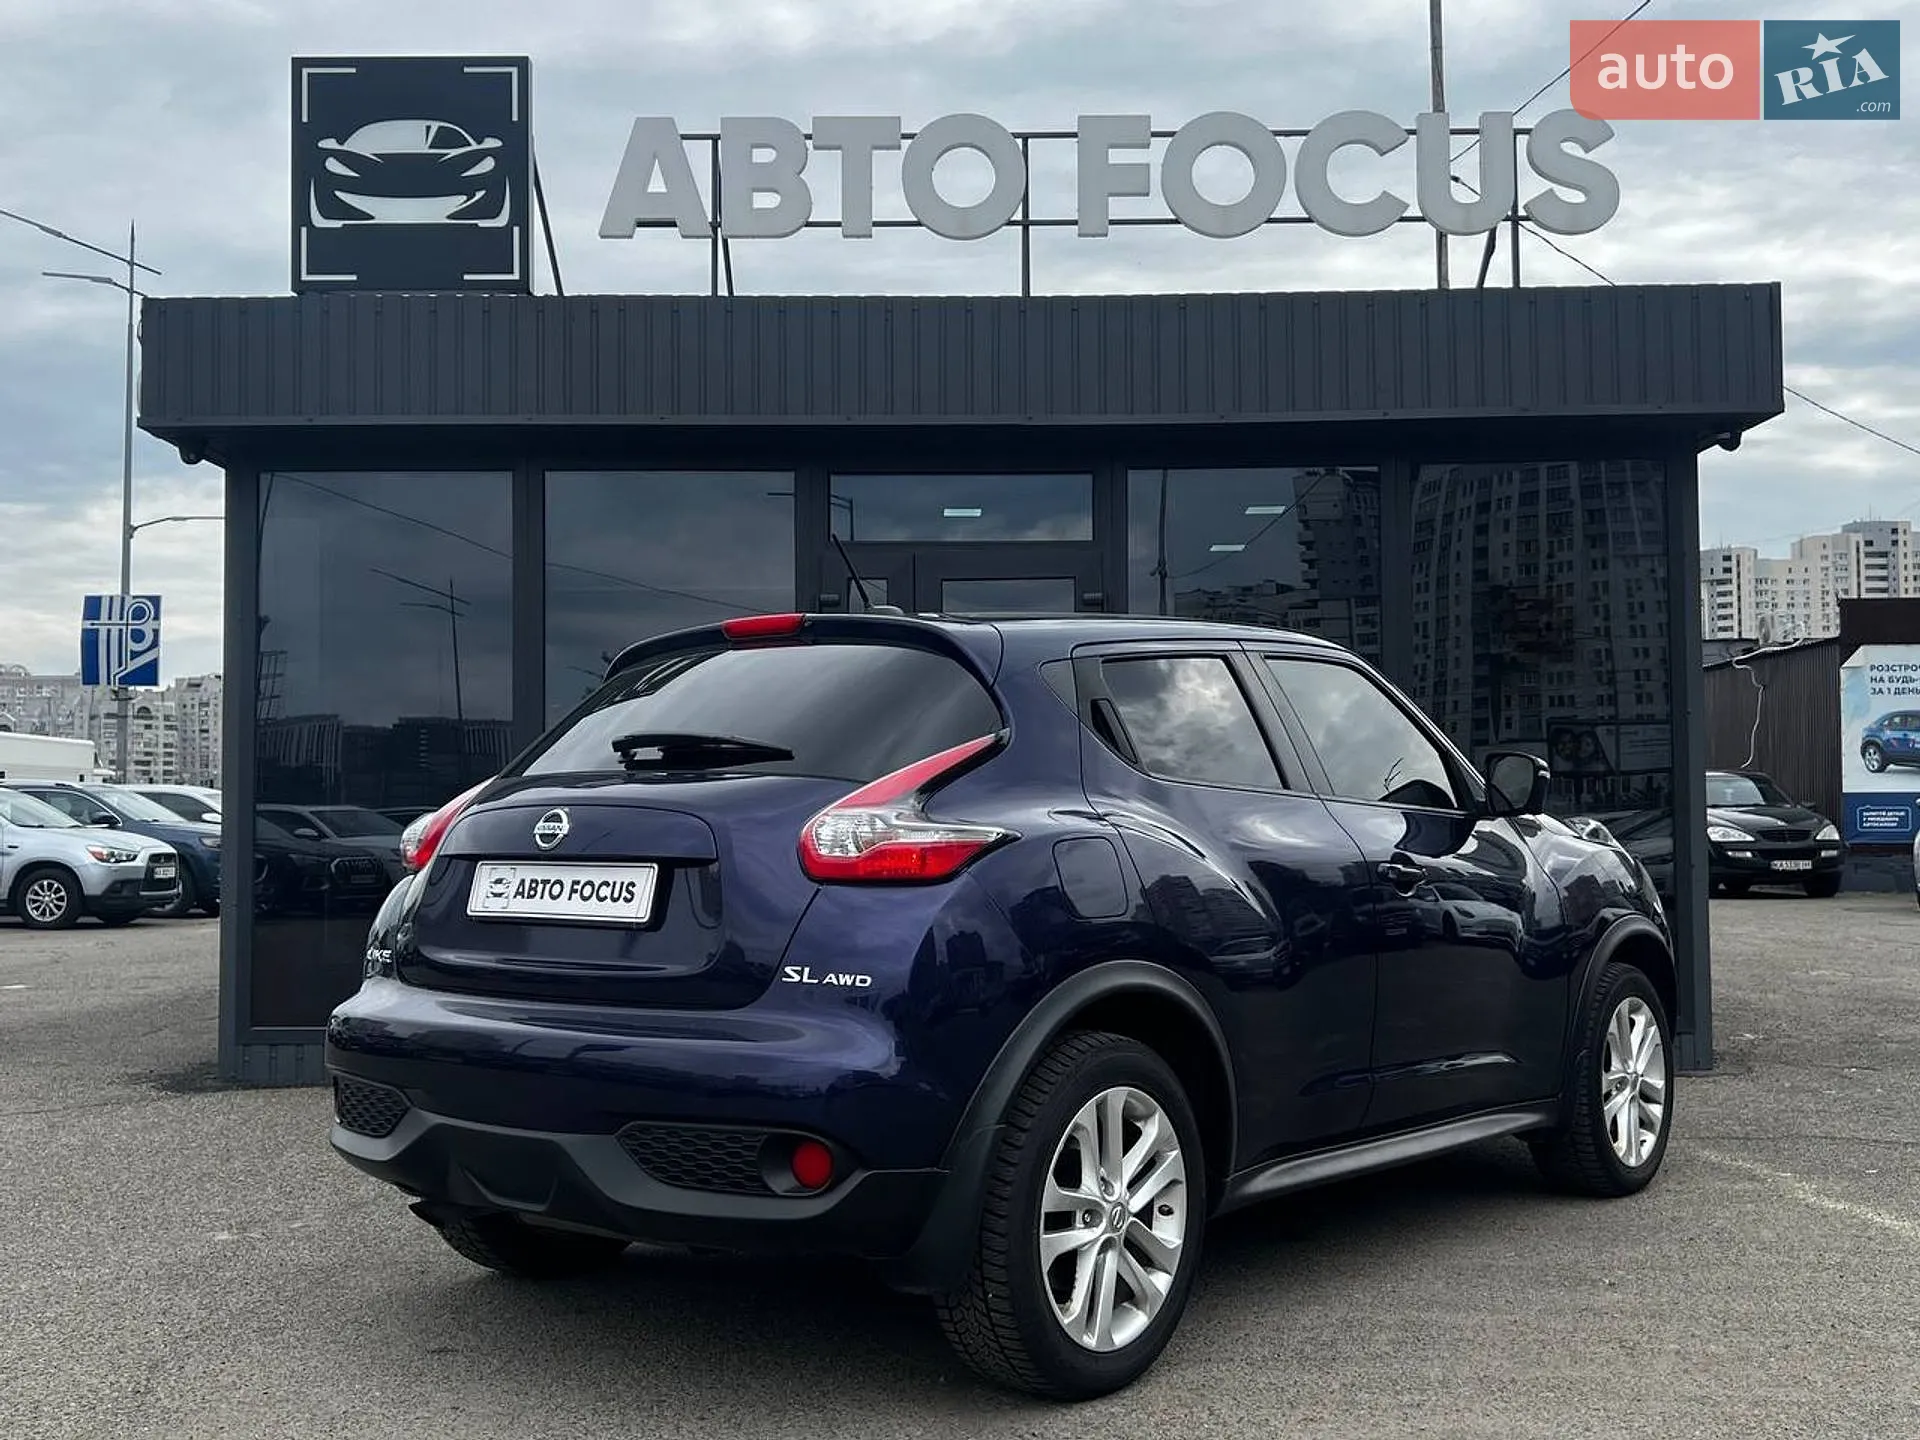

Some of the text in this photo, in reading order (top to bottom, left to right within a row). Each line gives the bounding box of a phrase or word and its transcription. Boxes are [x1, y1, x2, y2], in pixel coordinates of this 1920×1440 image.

[1077, 109, 1620, 238] FOCUS
[1888, 675, 1920, 684] БУДЬ-
[1870, 687, 1884, 695] ЗА
[1887, 687, 1891, 695] 1
[568, 879, 636, 904] FOCUS
[782, 965, 872, 987] SL AWD
